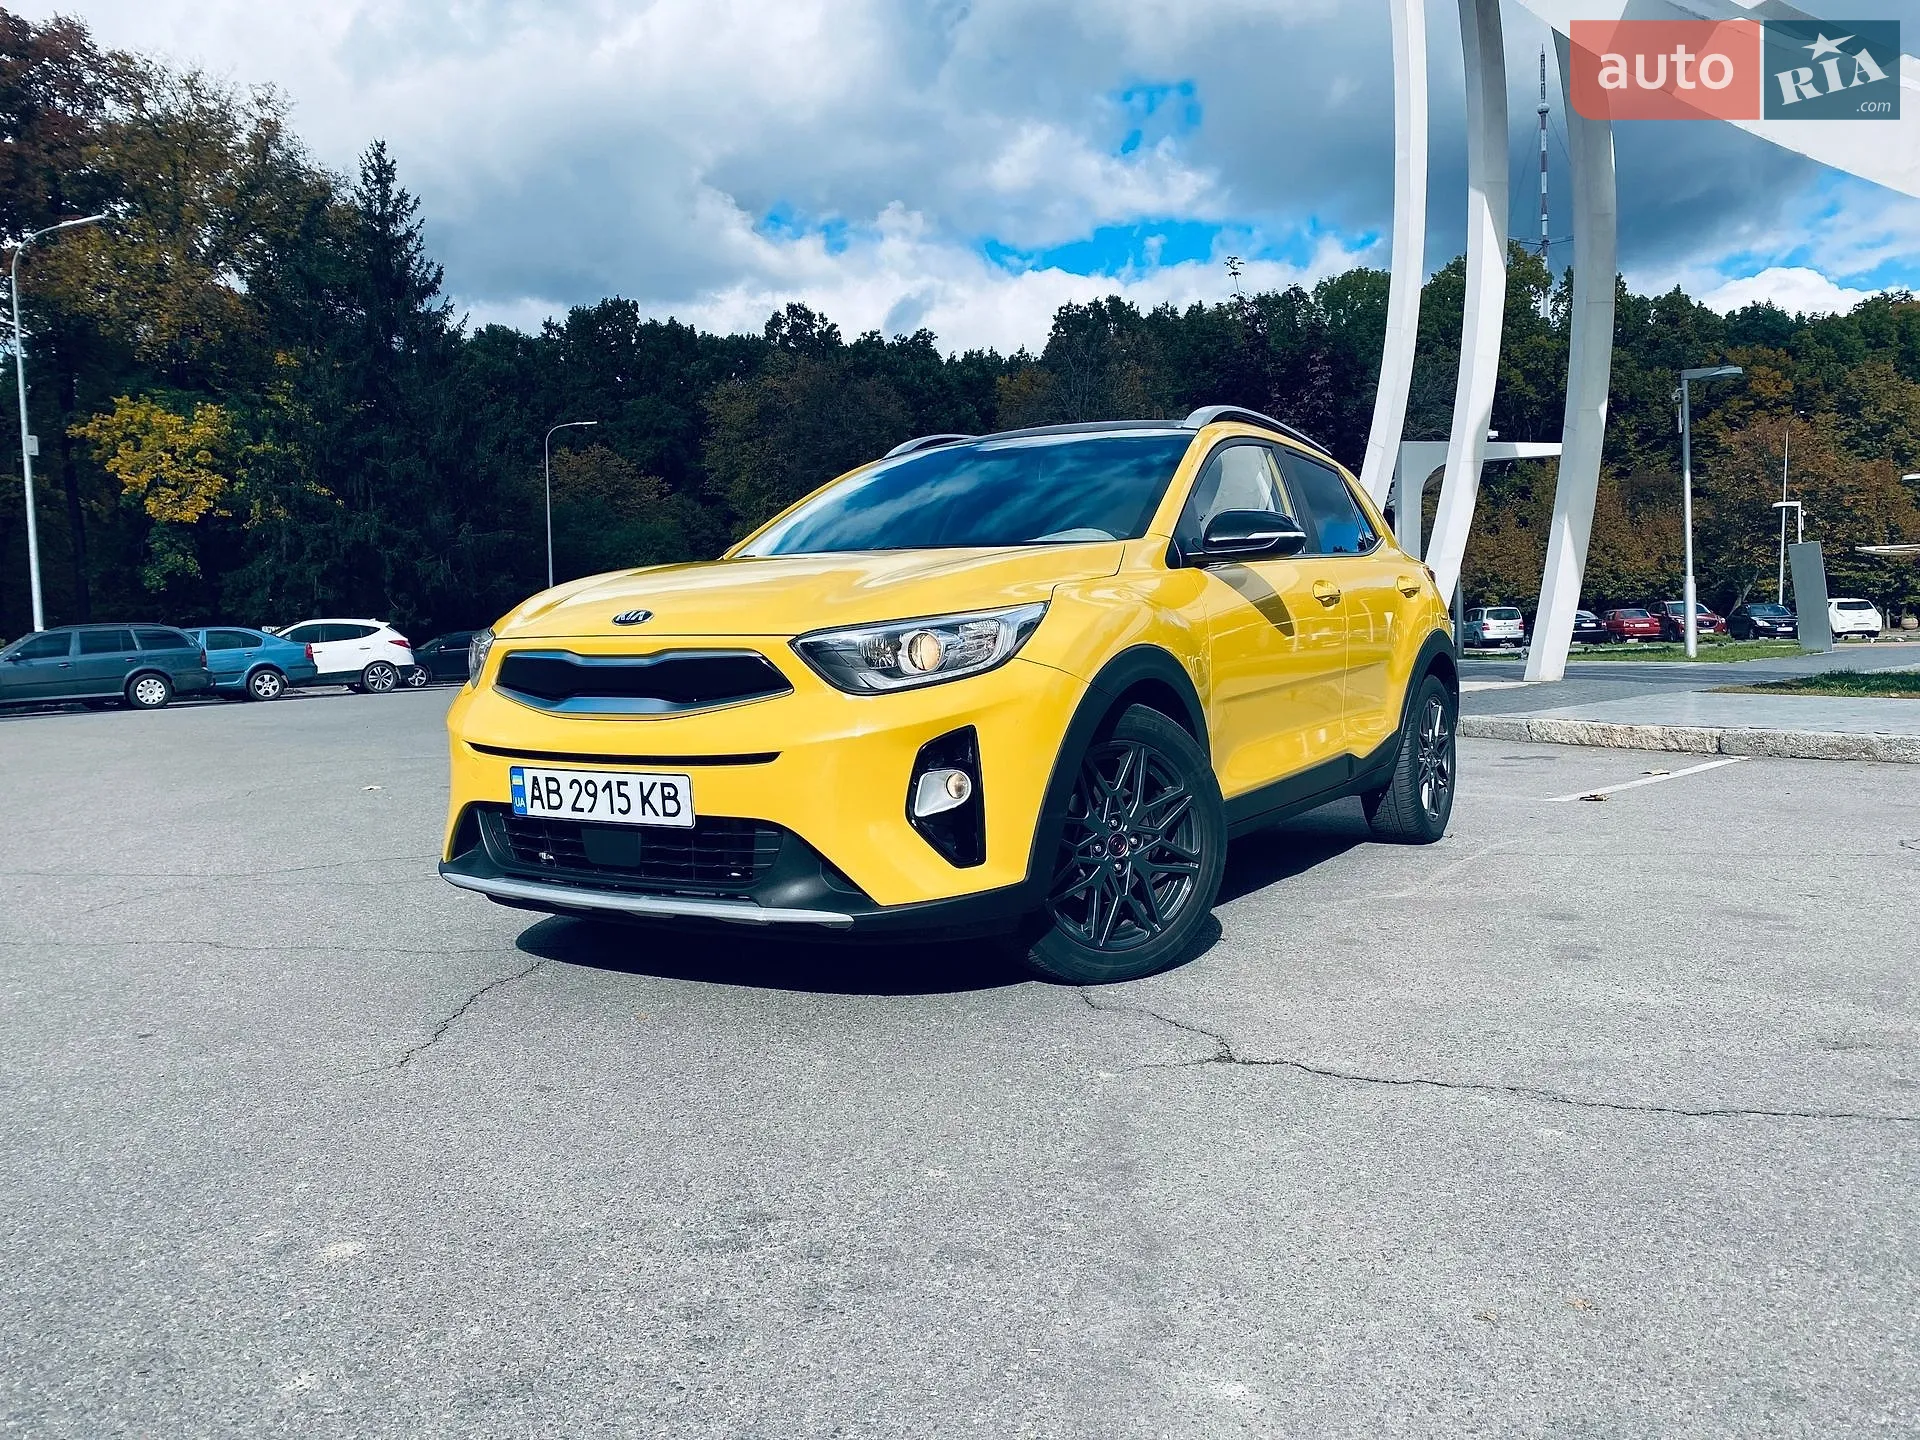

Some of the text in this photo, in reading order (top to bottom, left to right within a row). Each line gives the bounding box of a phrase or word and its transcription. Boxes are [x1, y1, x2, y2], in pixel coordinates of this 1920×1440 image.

[615, 611, 647, 621] KIA
[514, 796, 526, 808] UA
[530, 775, 682, 818] AB 2915 KB
